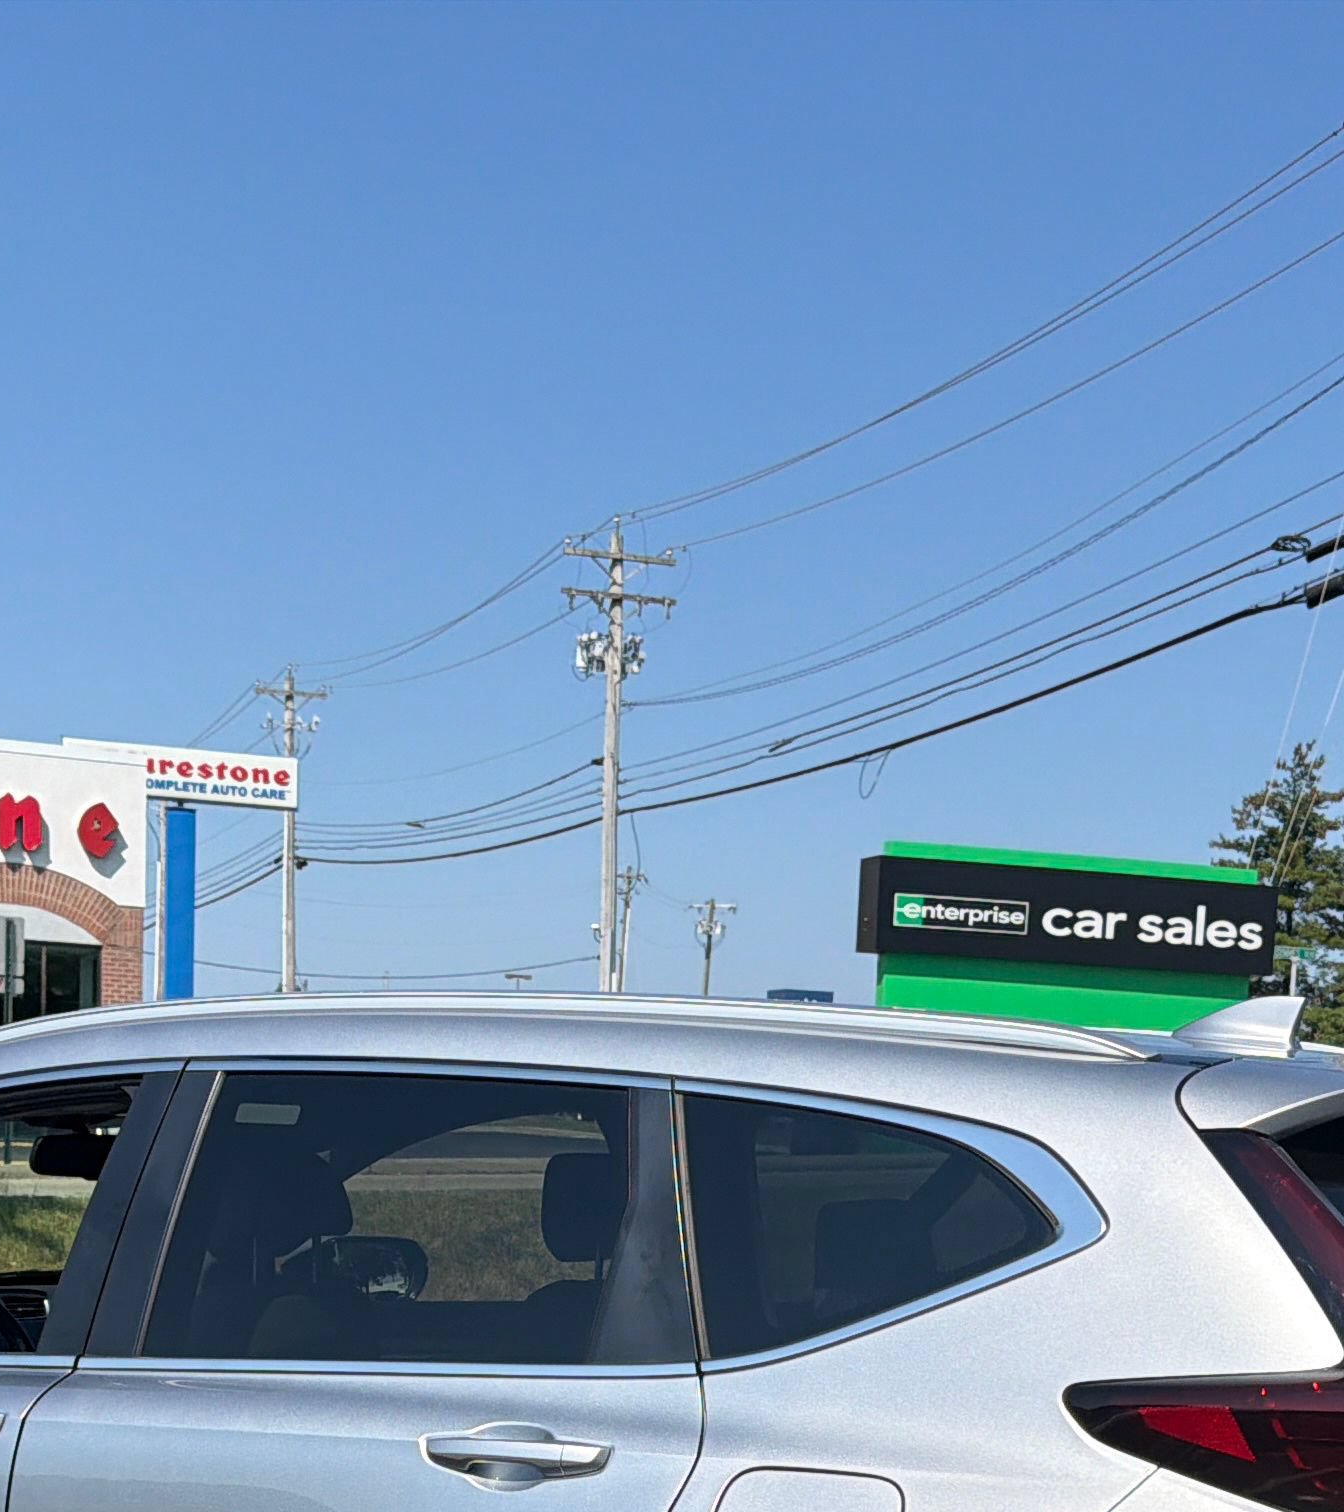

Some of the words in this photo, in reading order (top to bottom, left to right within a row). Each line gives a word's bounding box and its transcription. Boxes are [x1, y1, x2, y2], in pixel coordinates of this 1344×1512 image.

[211, 784, 248, 797] AUTO
[251, 788, 287, 800] CARE
[902, 902, 1025, 927] enterprise
[1041, 907, 1128, 940] car
[1137, 905, 1264, 951] sales
